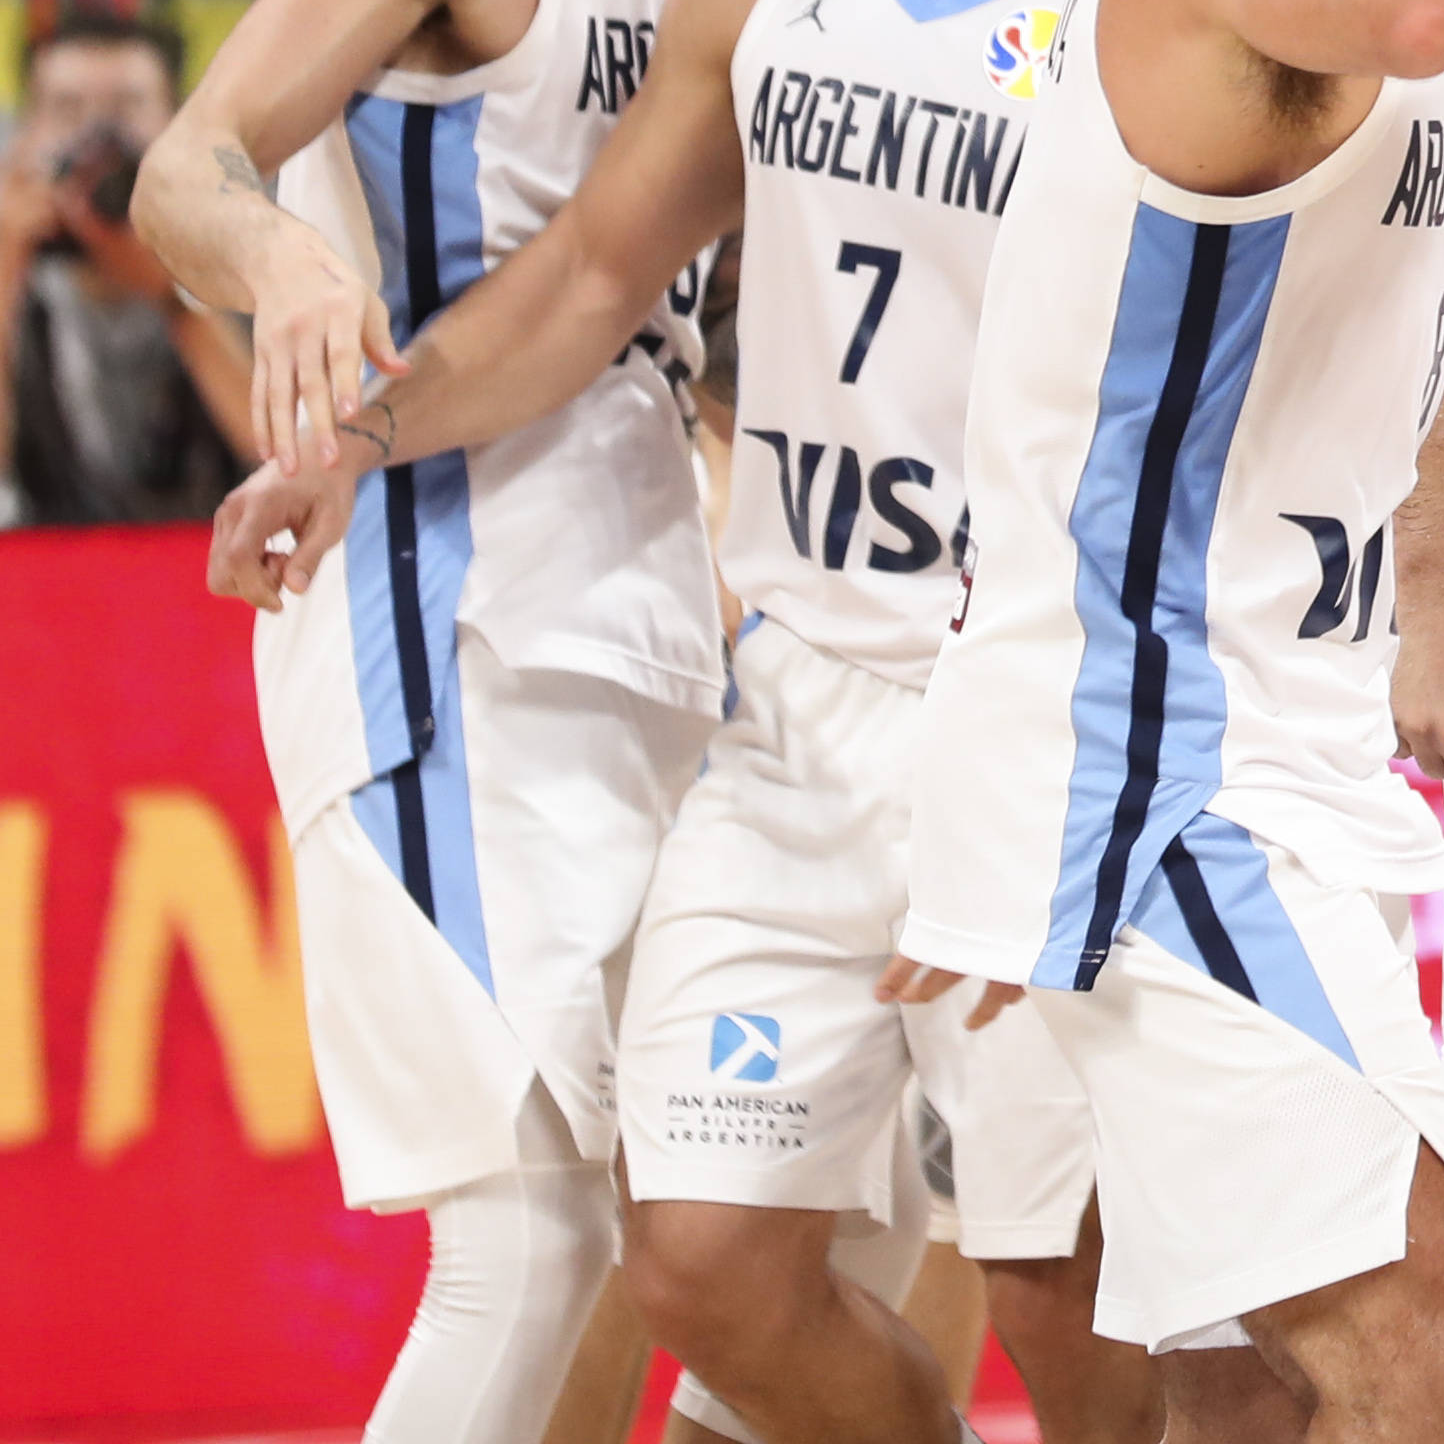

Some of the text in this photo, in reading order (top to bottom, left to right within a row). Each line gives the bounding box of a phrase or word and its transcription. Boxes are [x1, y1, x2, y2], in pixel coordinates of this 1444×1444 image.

[836, 240, 902, 385] 7
[742, 427, 970, 574] VIS
[667, 1094, 810, 1116] PAN AMERICAN
[701, 1115, 777, 1129] SILVER
[667, 1130, 805, 1149] ARGENTINA
